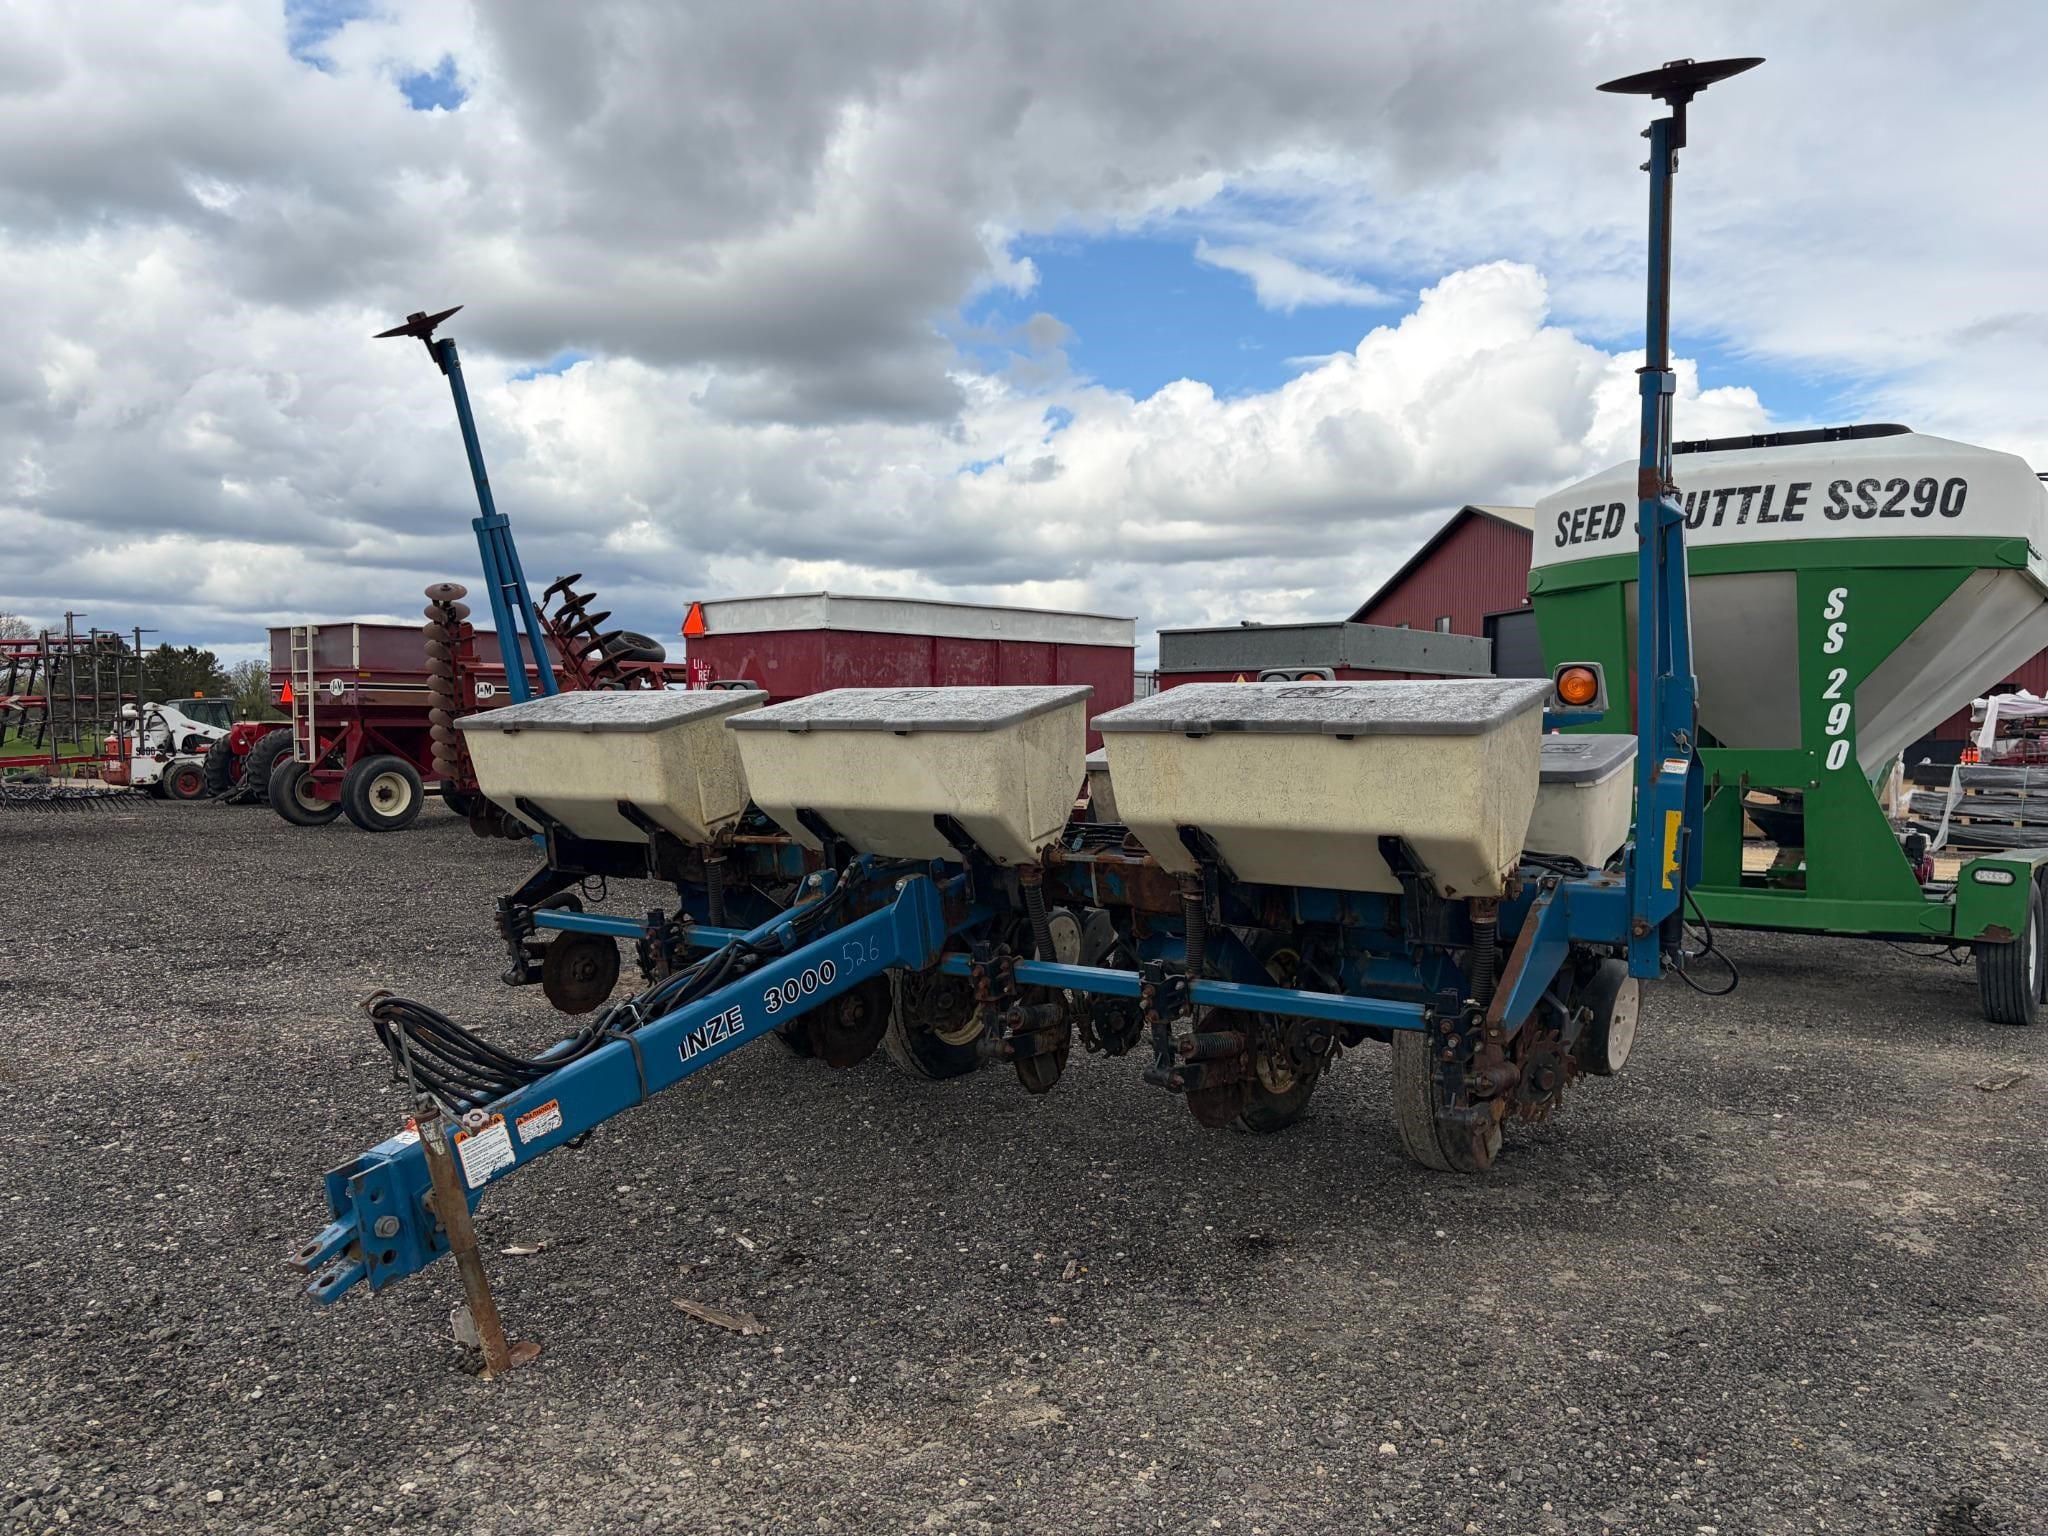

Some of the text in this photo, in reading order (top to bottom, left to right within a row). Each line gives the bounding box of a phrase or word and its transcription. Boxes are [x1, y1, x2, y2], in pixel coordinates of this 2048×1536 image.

[1555, 477, 1968, 548] SEED UTTLE SS290
[1822, 587, 1851, 771] SS 290
[764, 959, 836, 1013] 3000
[842, 935, 880, 976] 526
